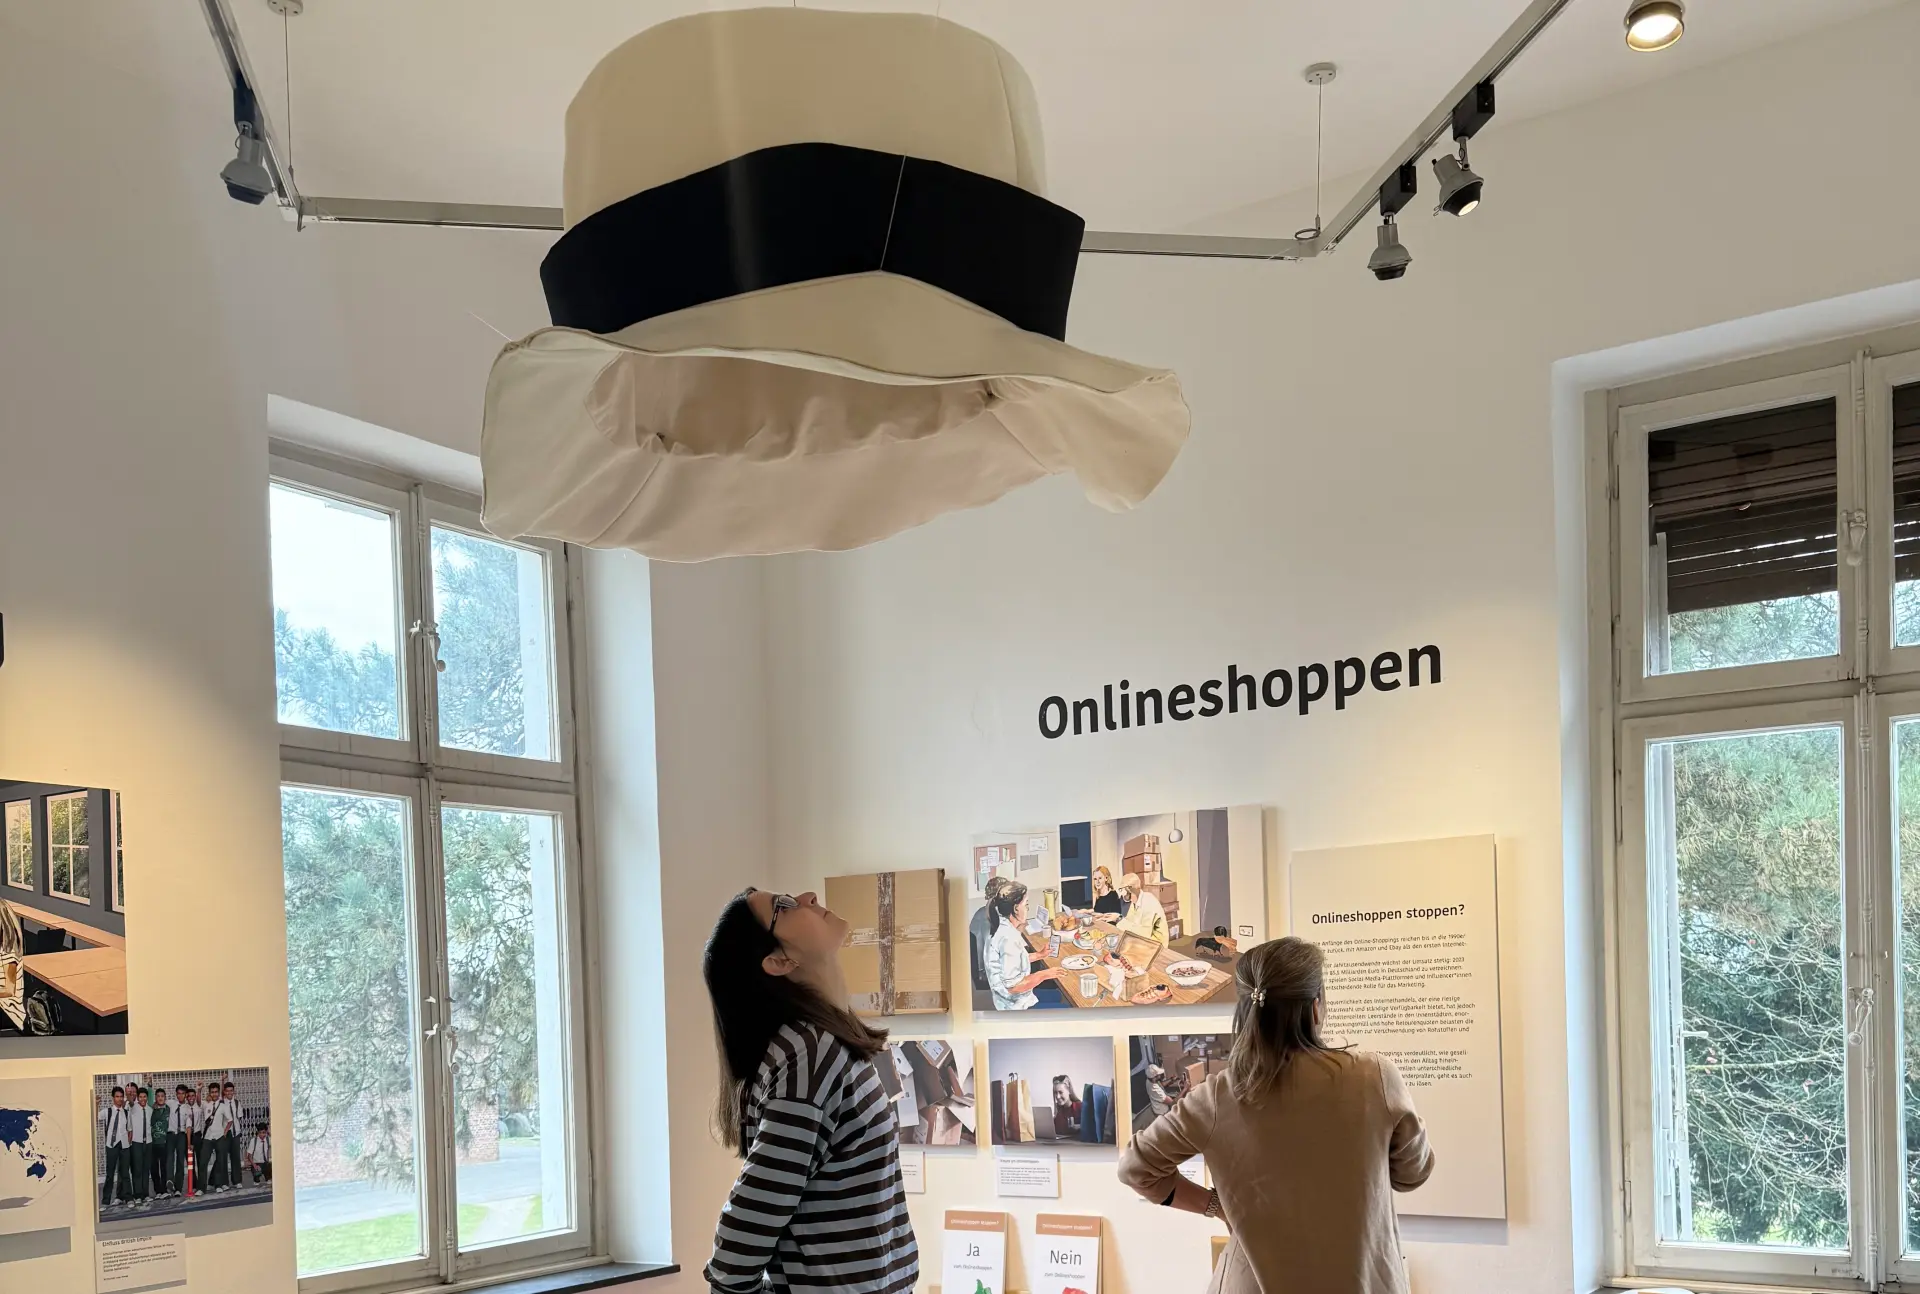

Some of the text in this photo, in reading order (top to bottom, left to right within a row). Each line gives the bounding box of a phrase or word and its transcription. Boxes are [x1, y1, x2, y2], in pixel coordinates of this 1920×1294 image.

[1037, 644, 1444, 739] Onlineshoppen
[1312, 904, 1466, 925] Onlineshoppen stoppen?
[967, 1243, 981, 1257] Ja
[1050, 1250, 1082, 1266] Nein
